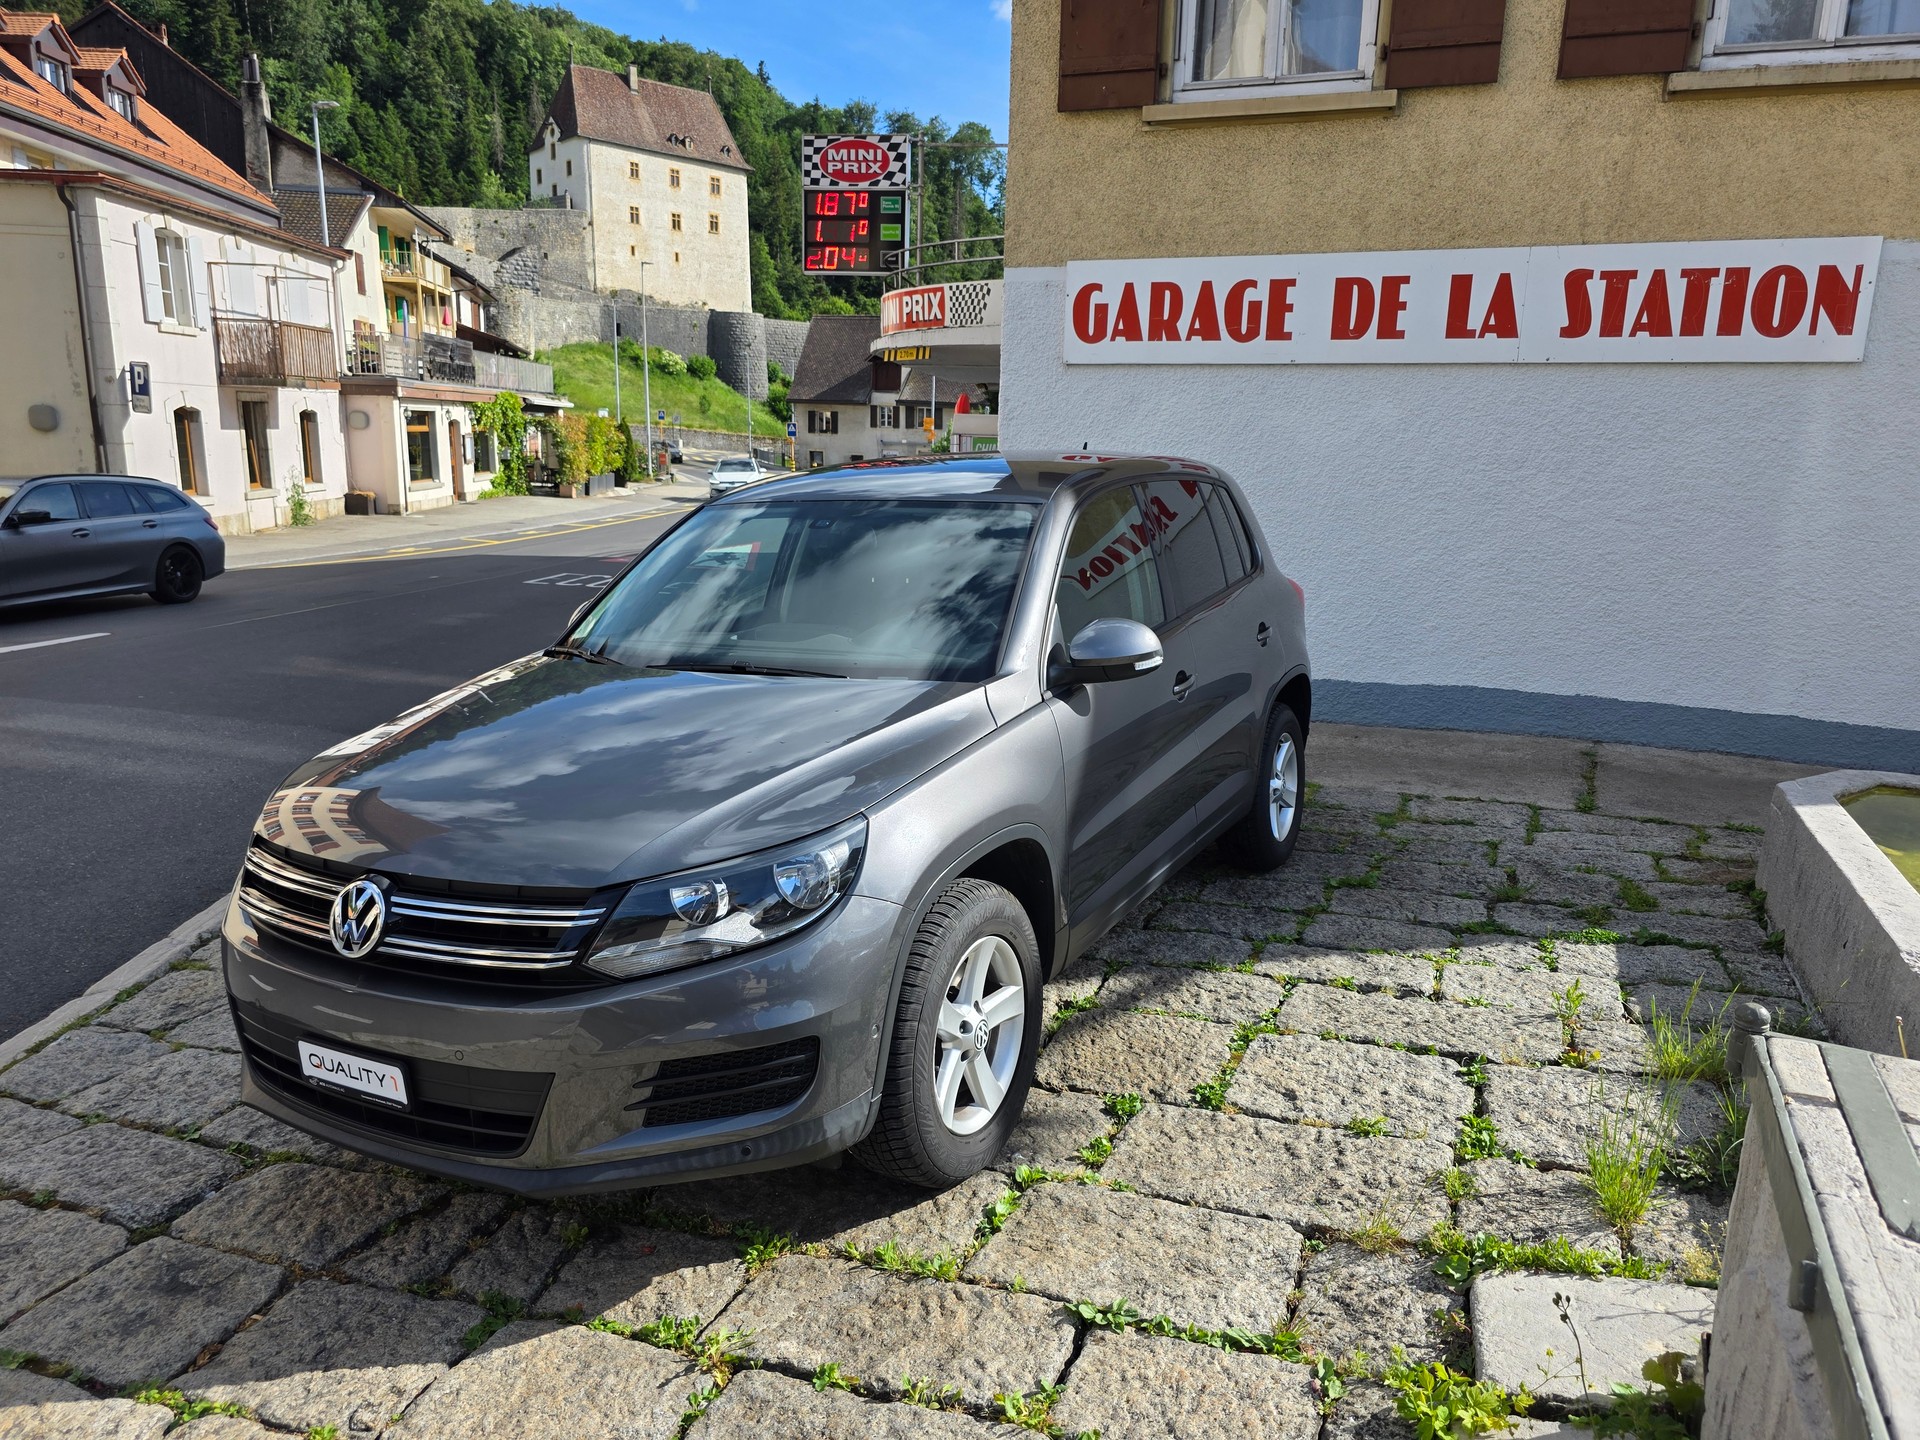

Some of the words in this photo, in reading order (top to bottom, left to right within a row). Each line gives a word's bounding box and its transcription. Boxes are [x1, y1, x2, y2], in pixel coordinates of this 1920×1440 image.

[827, 148, 883, 161] MINI
[827, 162, 883, 174] PRIX
[902, 291, 943, 323] PRIX
[1072, 278, 1297, 344] GARAGE
[1330, 275, 1411, 340] DE
[1445, 273, 1519, 339] LA
[1559, 264, 1865, 339] STATION
[134, 367, 145, 393] P
